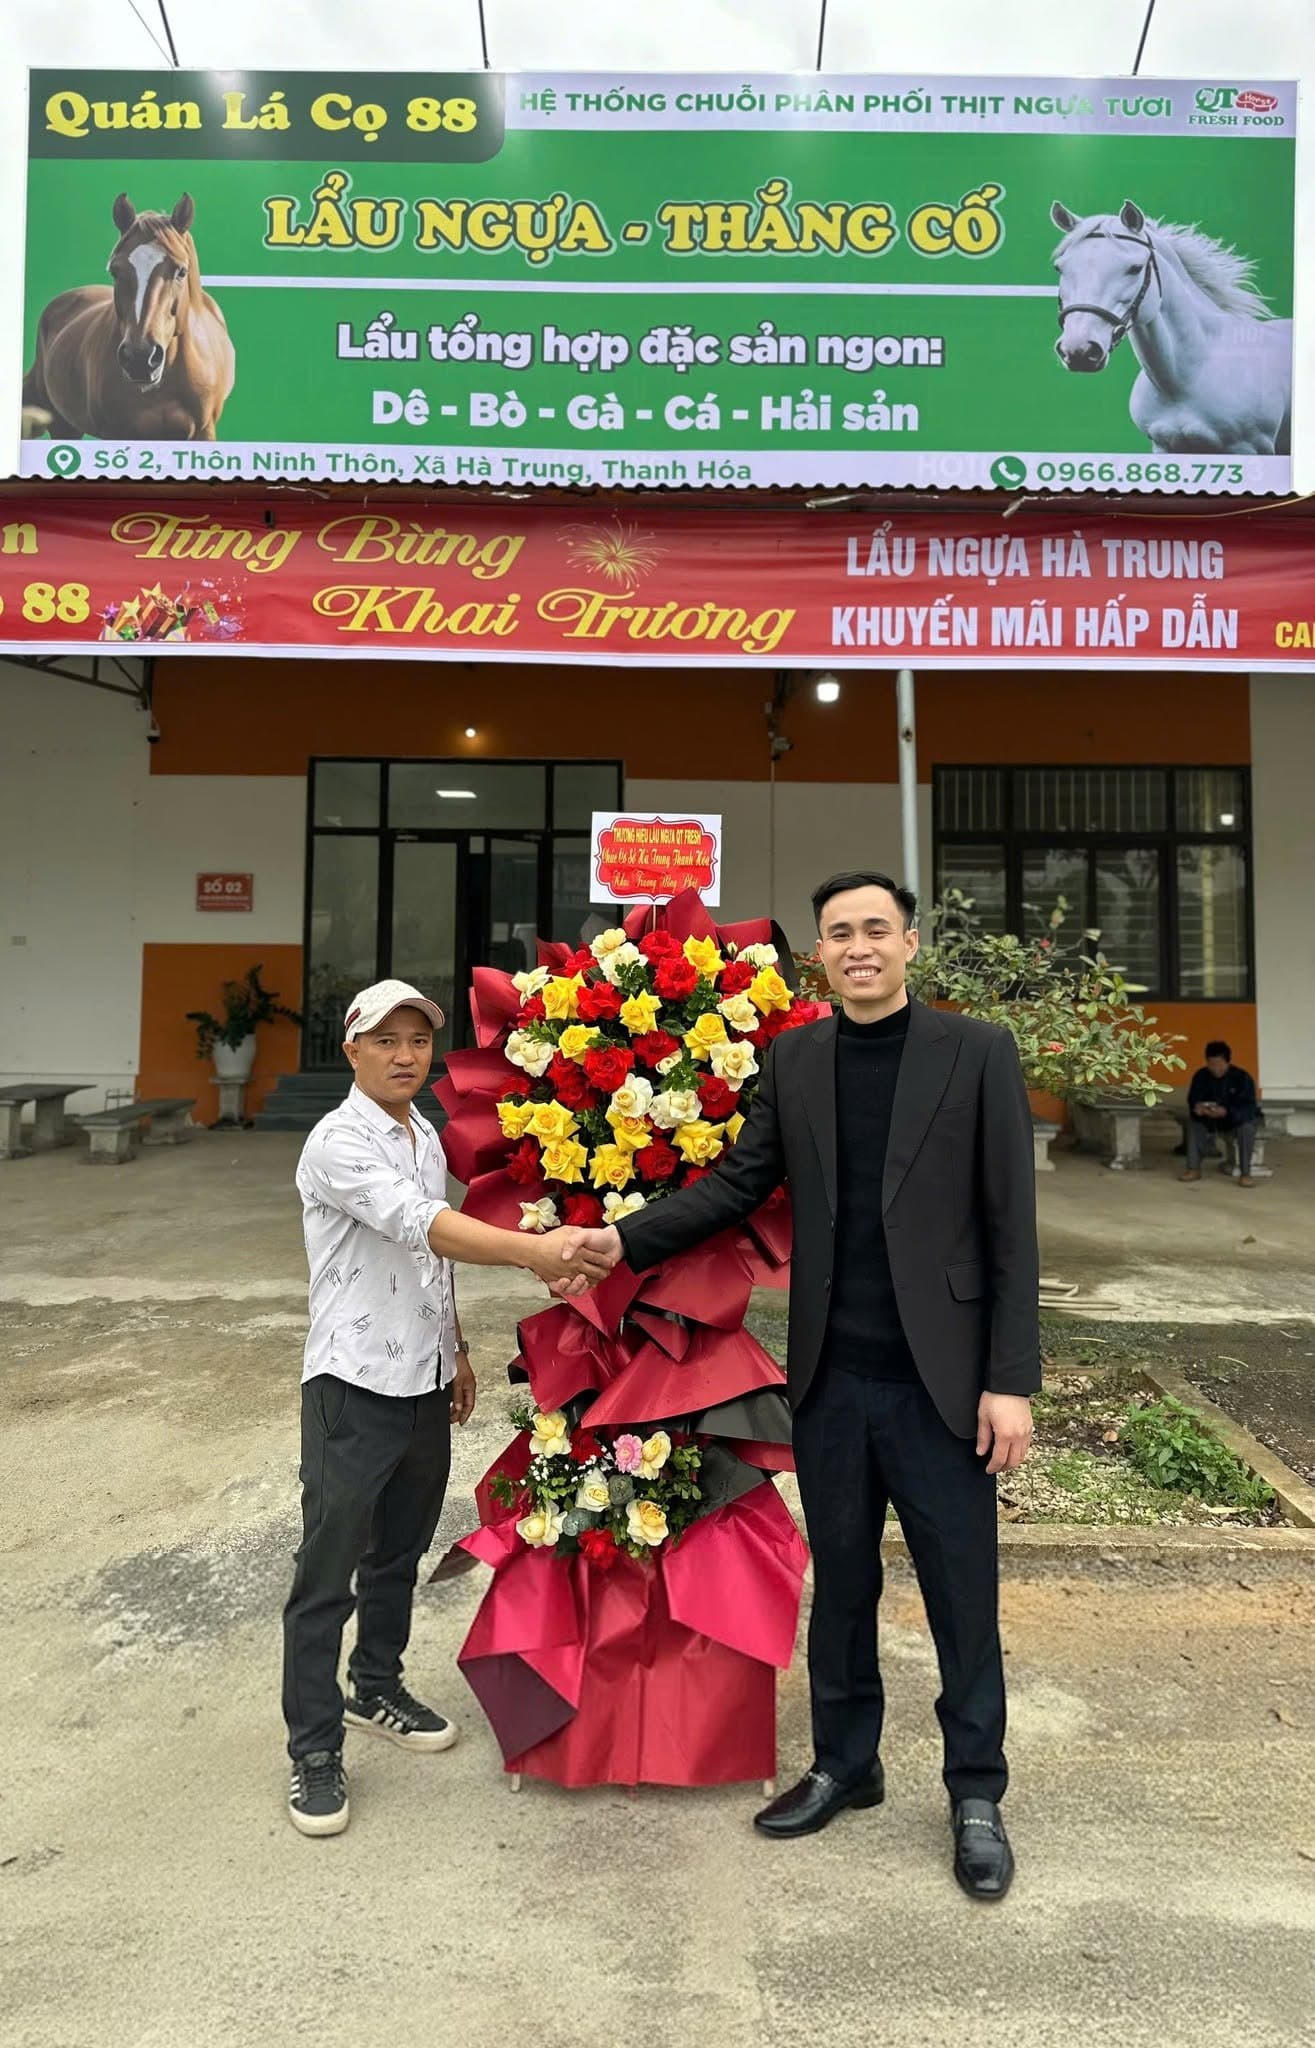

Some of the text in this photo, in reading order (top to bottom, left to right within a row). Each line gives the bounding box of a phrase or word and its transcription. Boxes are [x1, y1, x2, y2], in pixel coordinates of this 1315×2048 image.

[45, 90, 477, 142] Quán Lá Cọ 88
[520, 84, 1172, 119] HỆ THỐNG CHUỖI PHÂN PHỐI THỊT NGỰA TƯƠI
[1188, 115, 1285, 126] FRESH FOOD
[1195, 87, 1238, 113] QT
[263, 170, 401, 248] LẨU
[414, 194, 613, 266] NGỰA
[659, 178, 897, 255] THẮNG
[907, 183, 1005, 257] CỐ
[336, 312, 944, 374] Lẩu tổng hợp đặc sản ngon:
[372, 389, 429, 426] Dê
[470, 391, 526, 429] Bò
[567, 393, 624, 430] Gà
[664, 393, 720, 432] Cá
[761, 389, 831, 431] Hải
[843, 390, 919, 432] sản
[94, 446, 752, 483] Số 2, Thôn Ninh Thôn, Xã Hà Trung, Thanh Hóa
[1037, 461, 1245, 485] 0966.868.773
[110, 511, 526, 580] Tưng Bừng
[847, 521, 1224, 586] LẨU NGỰA HÀ TRUNG
[22, 582, 90, 623] 88
[312, 584, 796, 654] Khai Trương
[832, 593, 1238, 649] KHUYẾN MÃI HẤP DẪN
[1275, 621, 1315, 648] CA
[225, 881, 242, 893] 02
